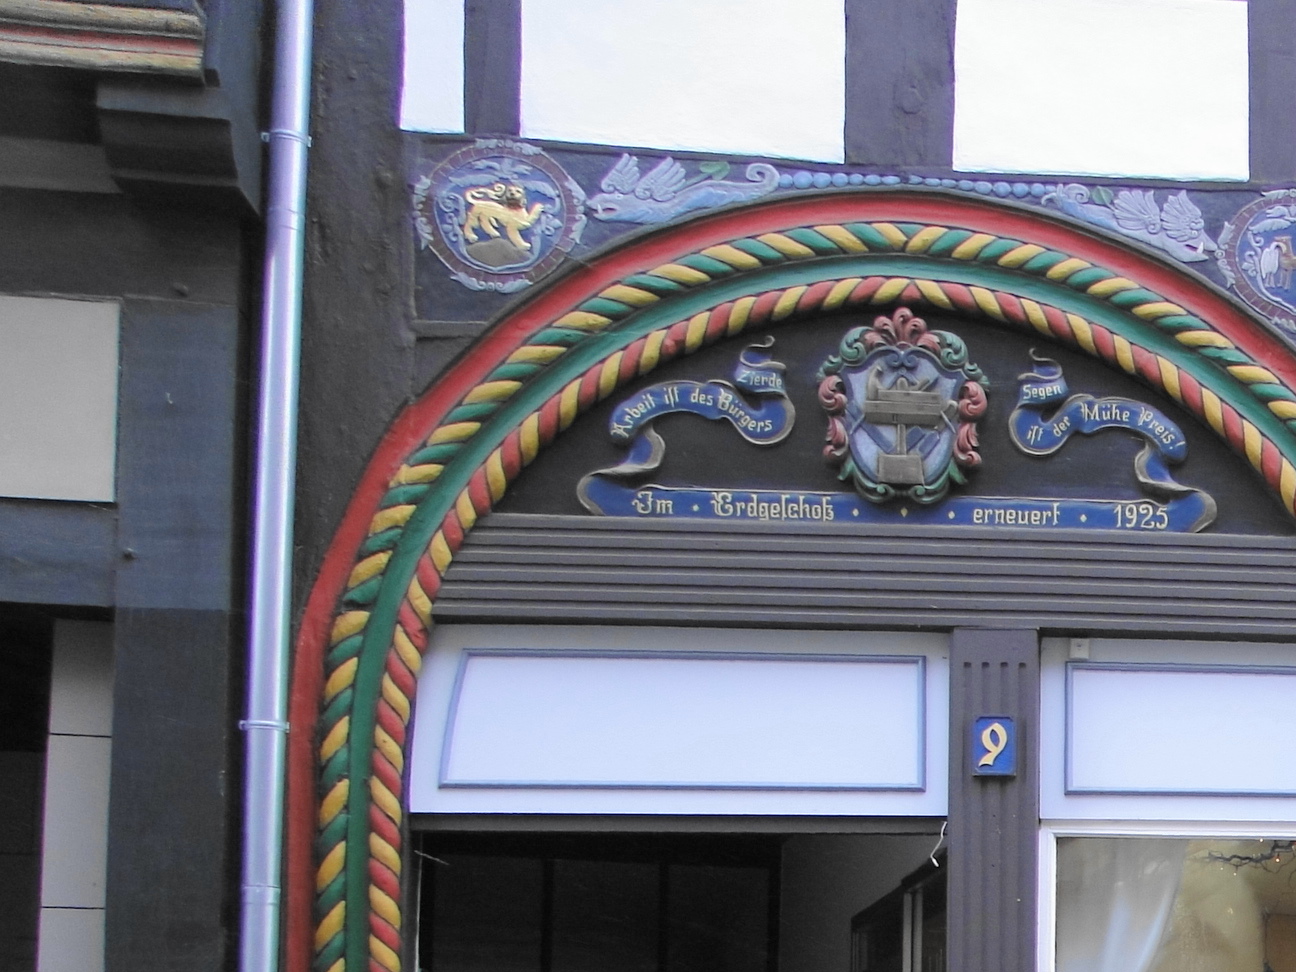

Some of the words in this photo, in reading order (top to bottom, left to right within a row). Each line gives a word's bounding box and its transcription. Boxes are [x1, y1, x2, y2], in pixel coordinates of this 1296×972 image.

[690, 388, 714, 406] des
[737, 370, 782, 389] Zierde
[610, 394, 656, 438] Arbeit
[717, 388, 773, 432] Bürgers
[1023, 383, 1062, 400] Segen
[1053, 415, 1071, 437] der
[1080, 402, 1130, 422] Mühe
[973, 503, 1060, 526] erneuert
[1113, 504, 1169, 530] 1925
[979, 723, 1008, 767] 9
